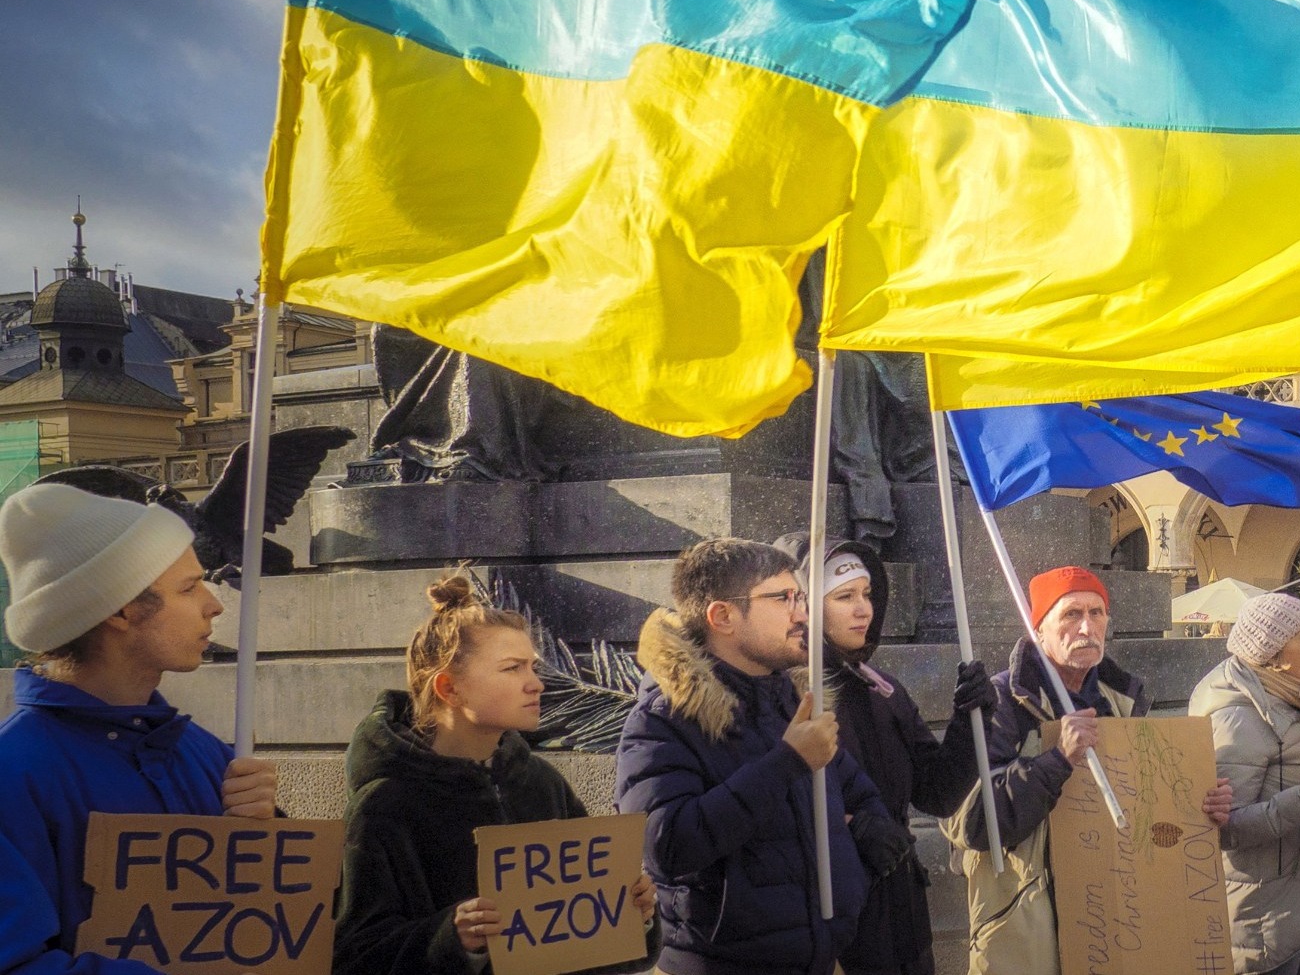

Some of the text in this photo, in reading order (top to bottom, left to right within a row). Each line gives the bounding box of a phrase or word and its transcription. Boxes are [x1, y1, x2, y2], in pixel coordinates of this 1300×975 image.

[1104, 754, 1138, 797] gift
[115, 828, 315, 894] FREE
[494, 836, 612, 892] FREE
[1079, 829, 1100, 851] is
[1181, 821, 1220, 903] AZOV
[105, 902, 325, 966] AZOV
[500, 884, 627, 952] AZOV
[1076, 883, 1110, 975] reedom
